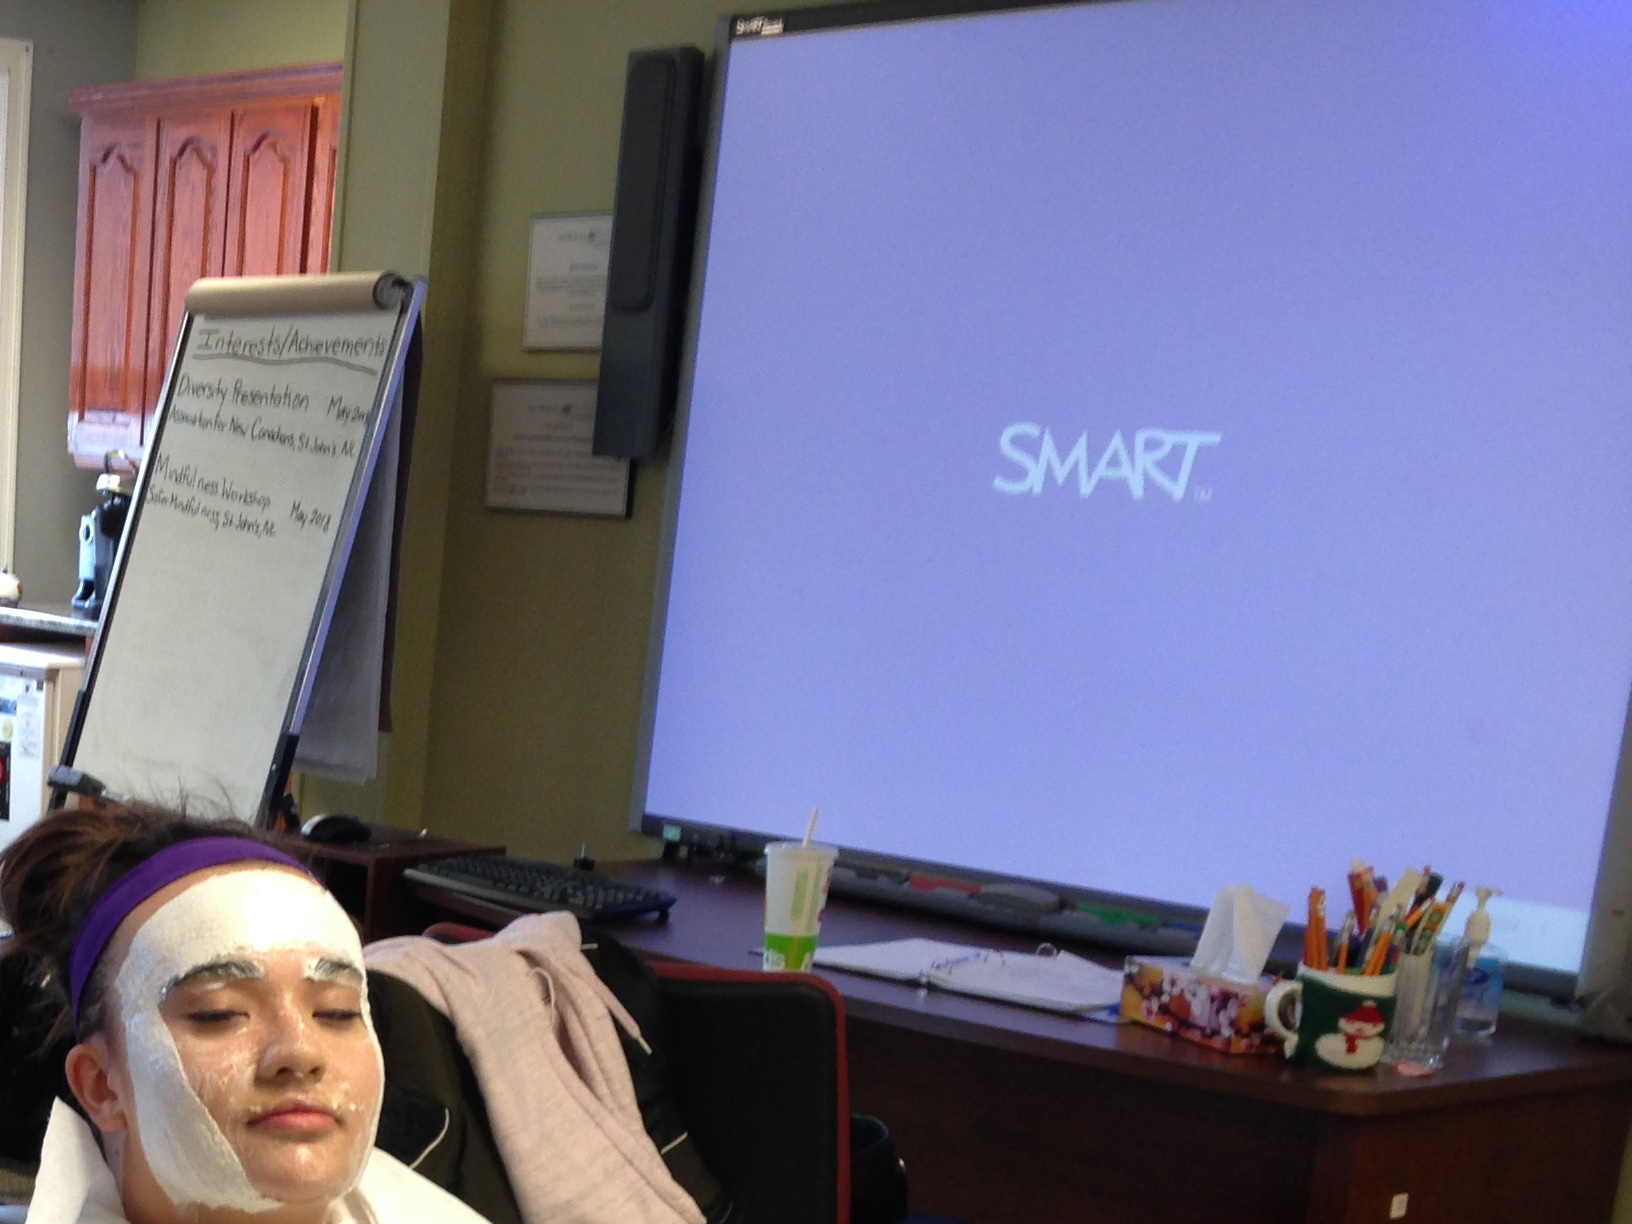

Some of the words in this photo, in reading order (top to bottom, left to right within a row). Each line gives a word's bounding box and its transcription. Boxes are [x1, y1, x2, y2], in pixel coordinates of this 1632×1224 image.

[178, 373, 227, 413] Diversity
[233, 378, 309, 411] Presentation
[993, 421, 1221, 502] SMART
